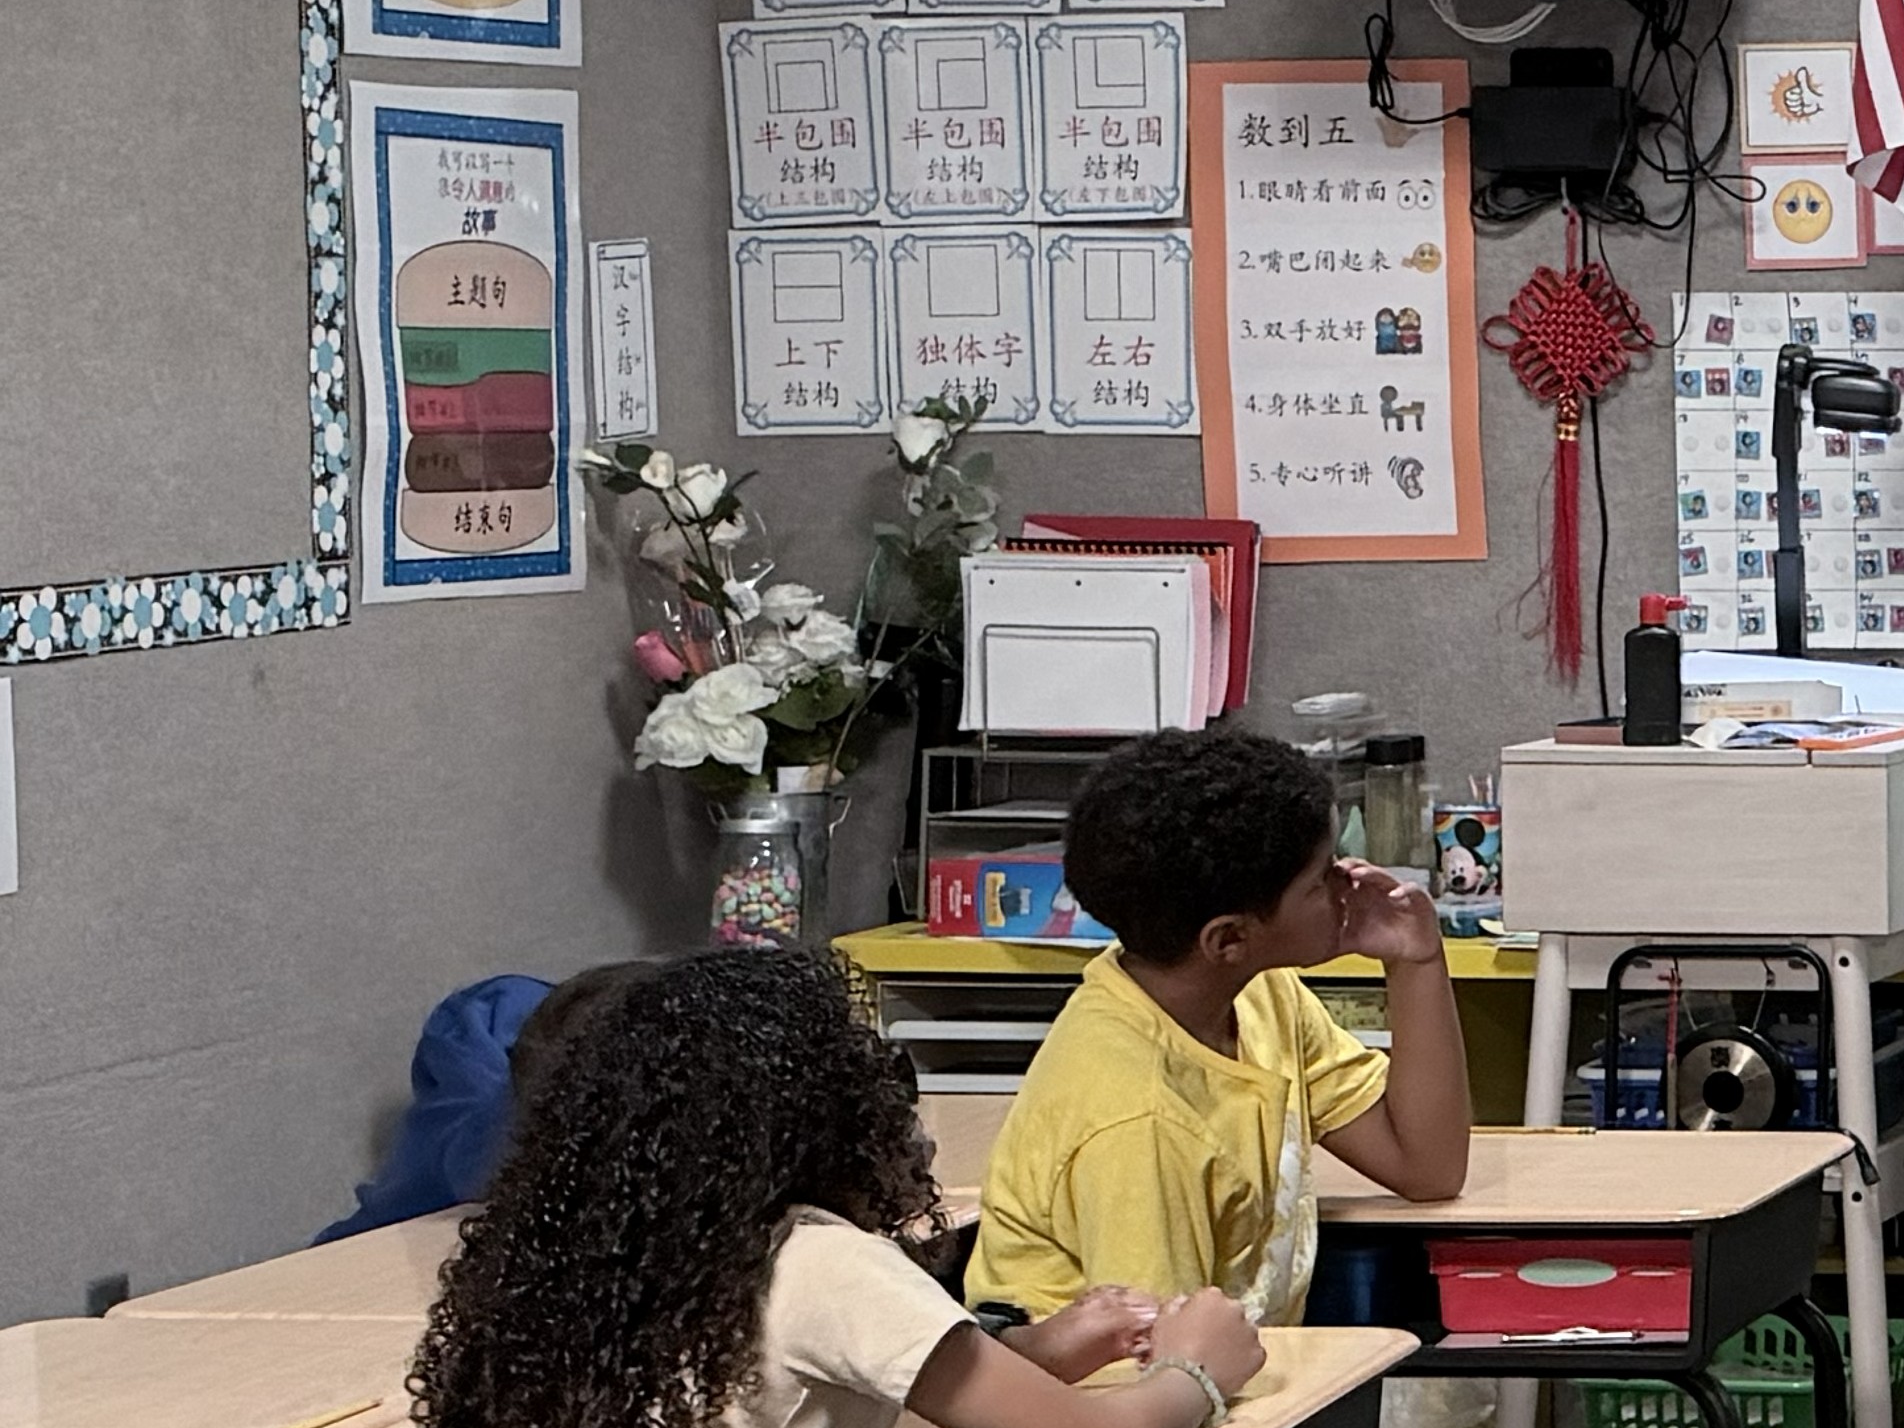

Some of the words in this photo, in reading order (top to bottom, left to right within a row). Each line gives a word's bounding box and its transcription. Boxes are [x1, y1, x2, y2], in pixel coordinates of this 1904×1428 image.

[754, 117, 858, 152] 半包围
[902, 117, 1006, 151] 半包围
[1059, 116, 1164, 149] 半包围
[1238, 113, 1354, 150] 数到五
[780, 156, 836, 184] 结构
[927, 156, 984, 183] 结构
[1083, 154, 1140, 181] 结构
[462, 207, 498, 236] 故事
[447, 275, 507, 309] 主题句
[775, 336, 844, 369] 上下
[916, 334, 1024, 367] 独体字
[1086, 336, 1155, 368] 左右
[783, 381, 840, 408] 结构
[1093, 380, 1150, 407] 结构
